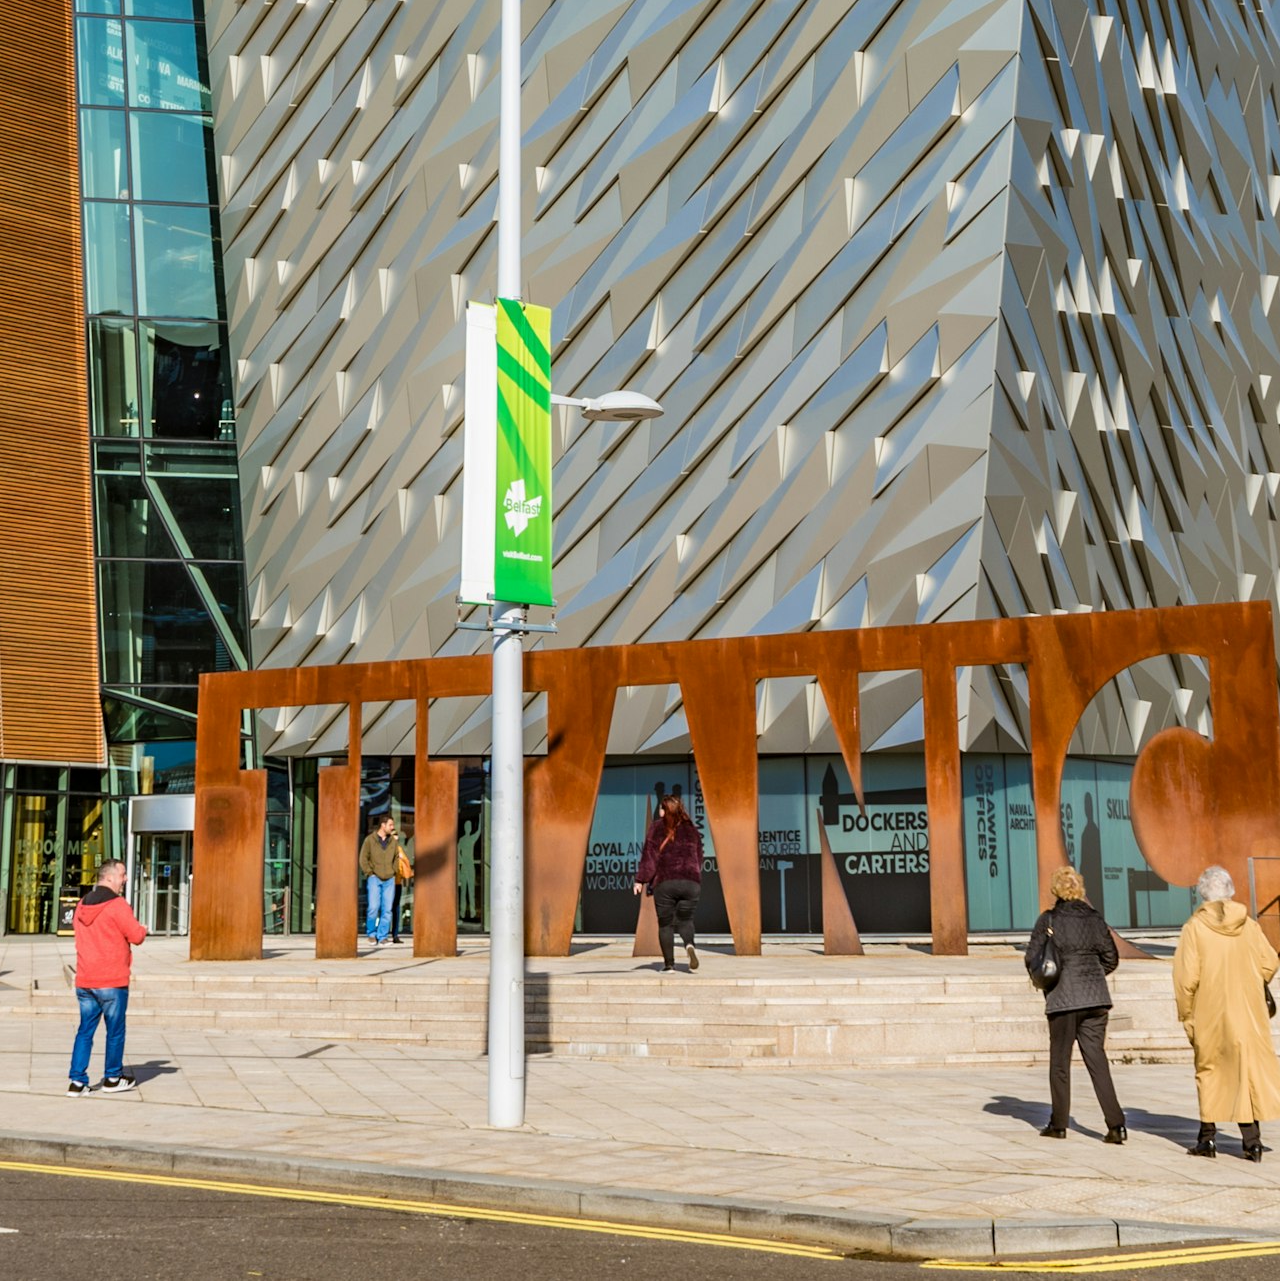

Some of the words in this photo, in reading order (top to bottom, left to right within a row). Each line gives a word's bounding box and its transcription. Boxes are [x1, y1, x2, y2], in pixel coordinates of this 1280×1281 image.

[506, 498, 540, 514] Belfast
[974, 764, 987, 861] OFFICES
[1009, 803, 1033, 817] NAVAL
[1107, 797, 1131, 821] SKILL
[842, 810, 928, 832] DOCKERS
[984, 764, 998, 878] DRAWING
[1010, 818, 1036, 831] ARCHIT
[759, 829, 801, 842] RENTICE
[891, 832, 929, 851] AND
[1065, 803, 1076, 870] GUST
[626, 842, 644, 856] AN
[760, 843, 801, 855] BOURER
[844, 853, 929, 875] CARTERS
[585, 875, 635, 890] WORKM
